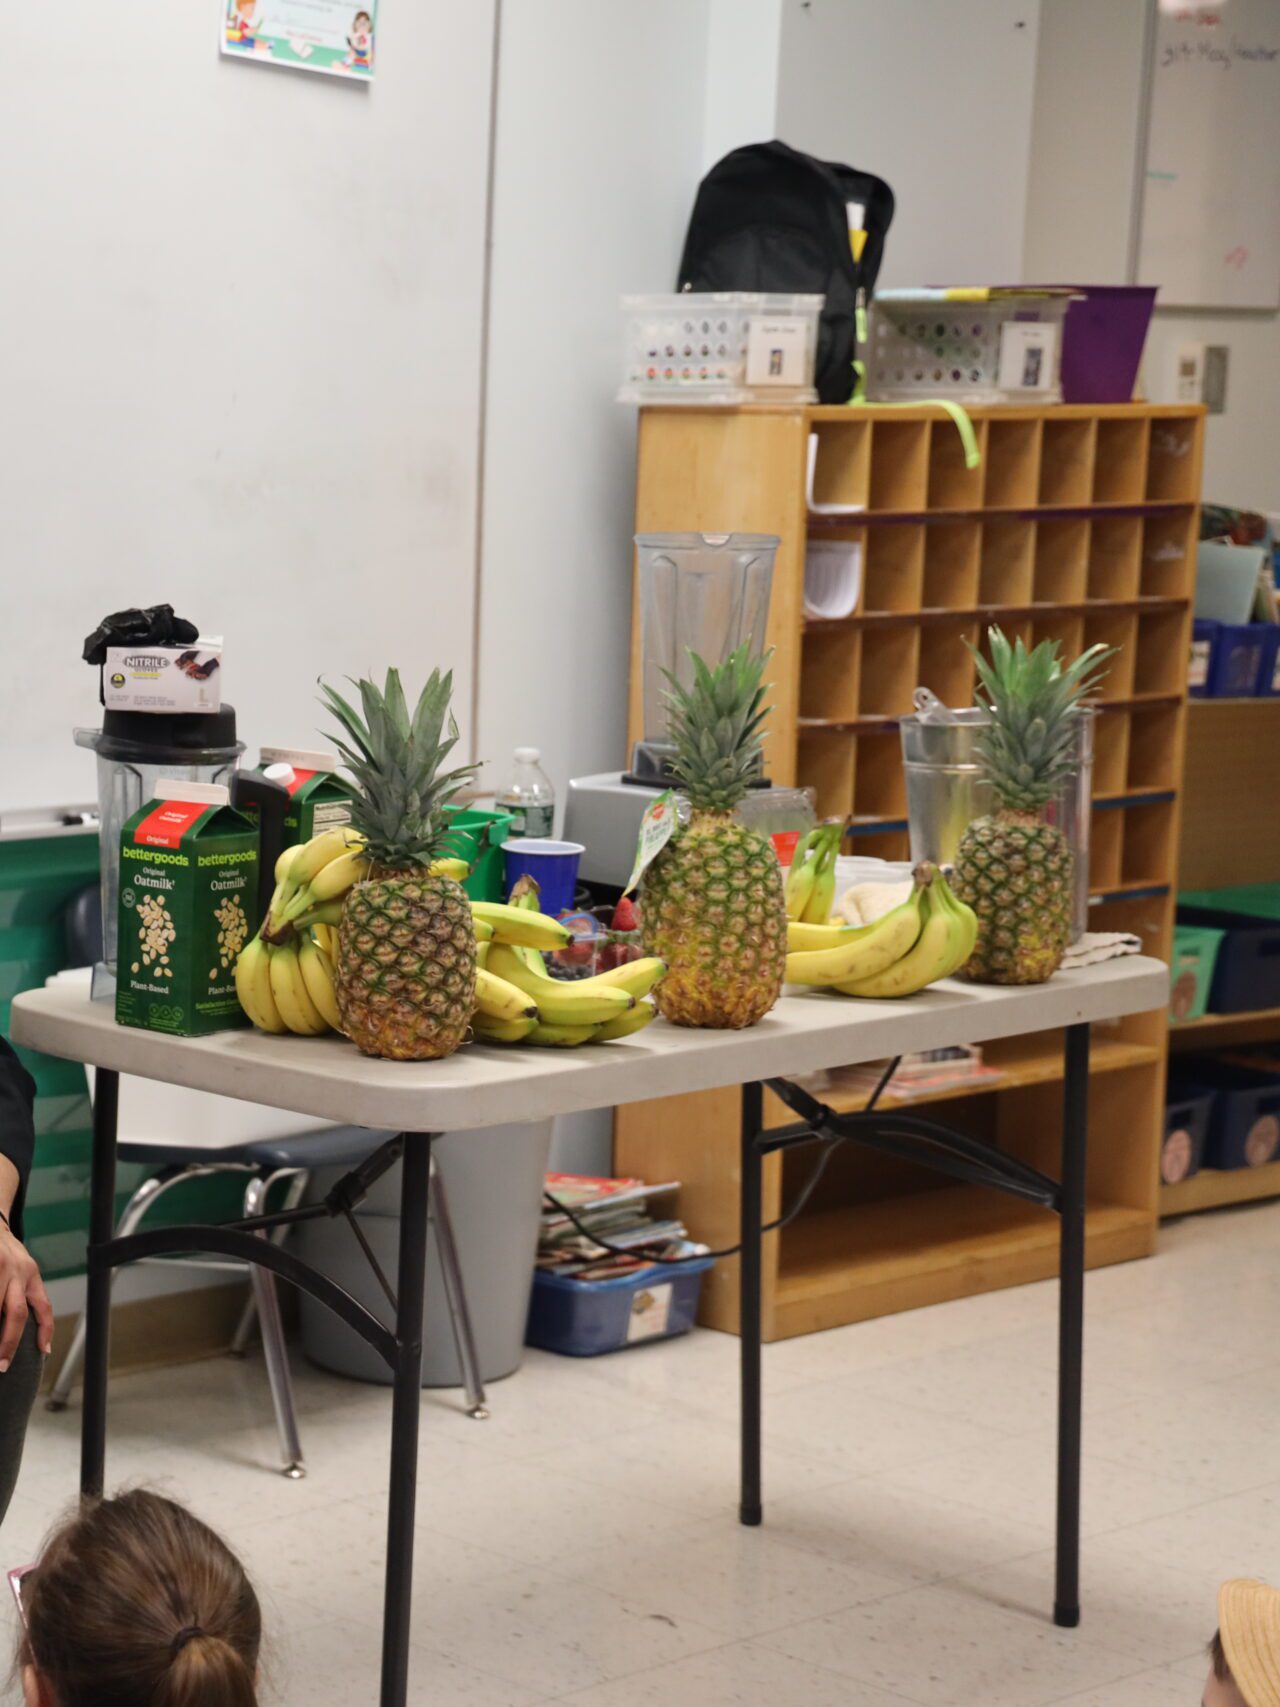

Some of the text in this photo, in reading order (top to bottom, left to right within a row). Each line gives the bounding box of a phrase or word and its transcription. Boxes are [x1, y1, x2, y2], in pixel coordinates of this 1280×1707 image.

[126, 657, 167, 668] NITRILE
[147, 835, 169, 845] Original
[123, 846, 189, 867] bettergoods
[198, 850, 257, 867] bettergoods
[143, 867, 166, 876] Original
[219, 869, 240, 878] Original
[130, 980, 169, 994] Plant-Based
